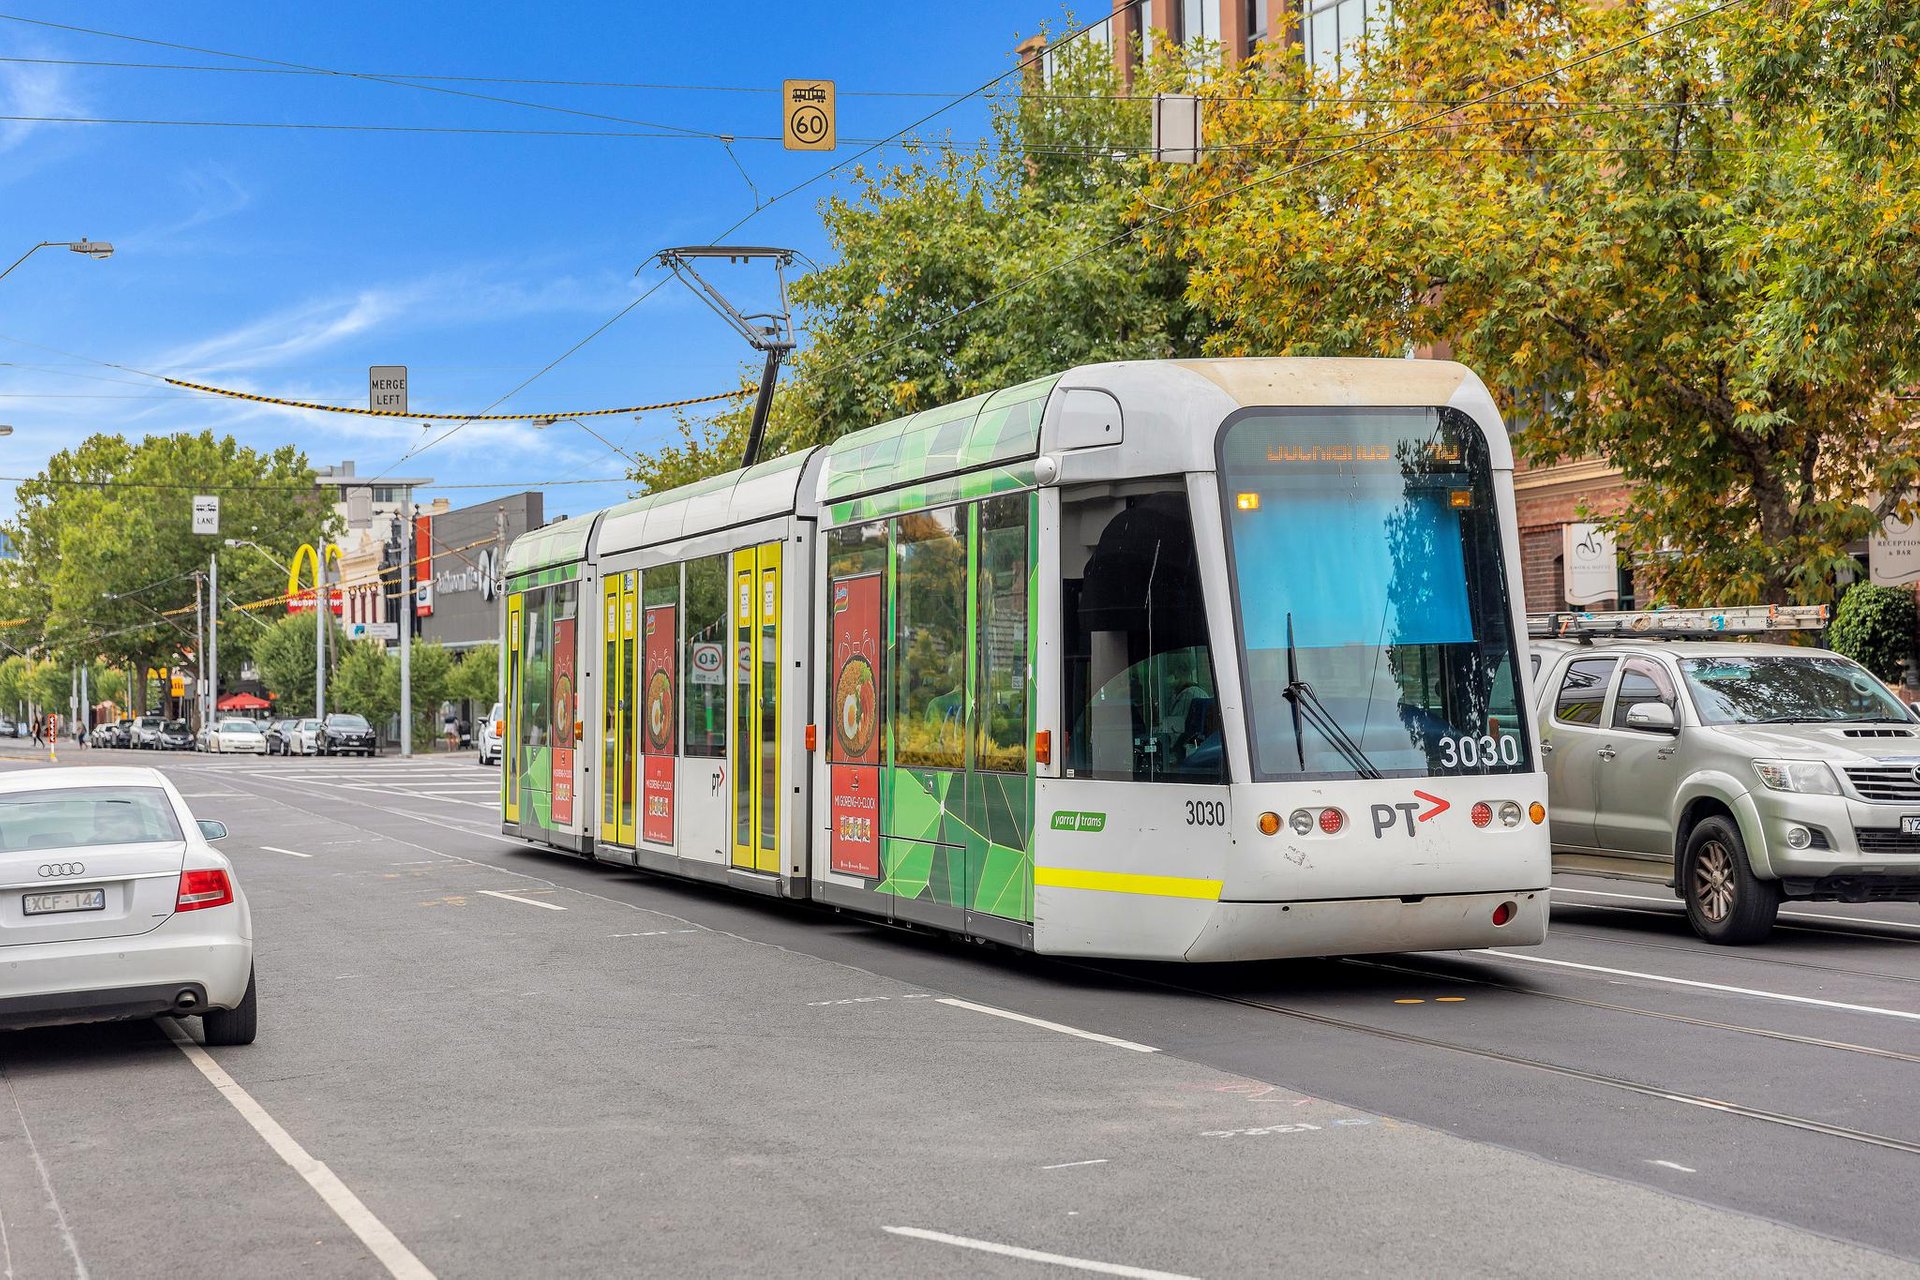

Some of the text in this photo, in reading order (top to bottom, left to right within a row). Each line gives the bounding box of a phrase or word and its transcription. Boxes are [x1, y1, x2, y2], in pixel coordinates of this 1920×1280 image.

[796, 115, 823, 134] 60
[372, 379, 405, 390] MERGE
[376, 394, 400, 405] LEFT
[196, 517, 215, 525] LANE
[1438, 735, 1519, 768] 3030
[1185, 800, 1225, 827] 3030
[1054, 815, 1102, 827] yarra trams
